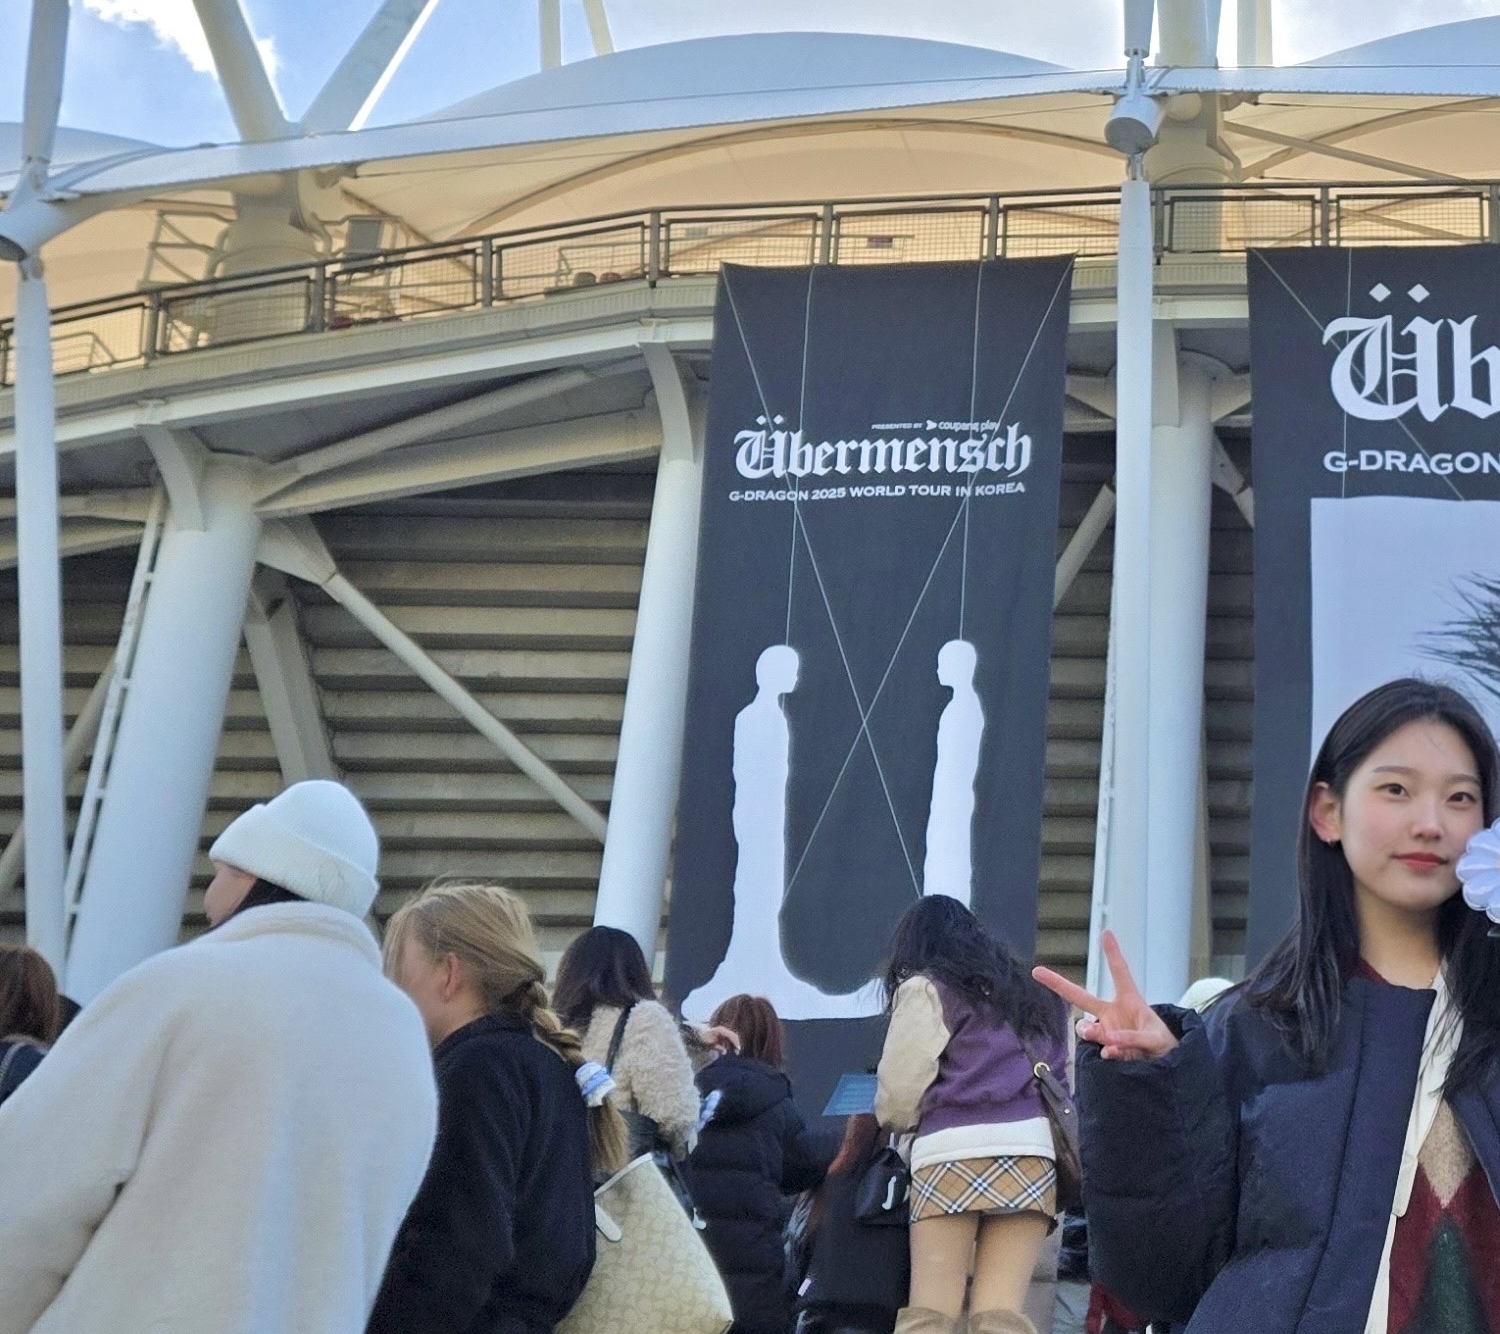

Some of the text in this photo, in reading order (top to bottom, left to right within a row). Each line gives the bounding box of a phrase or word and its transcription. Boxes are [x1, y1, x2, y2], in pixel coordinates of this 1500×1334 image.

[733, 414, 1032, 479] Übermensch
[729, 482, 1026, 502] G-DRAGON 2025 WORLD TOUR IN KOREA
